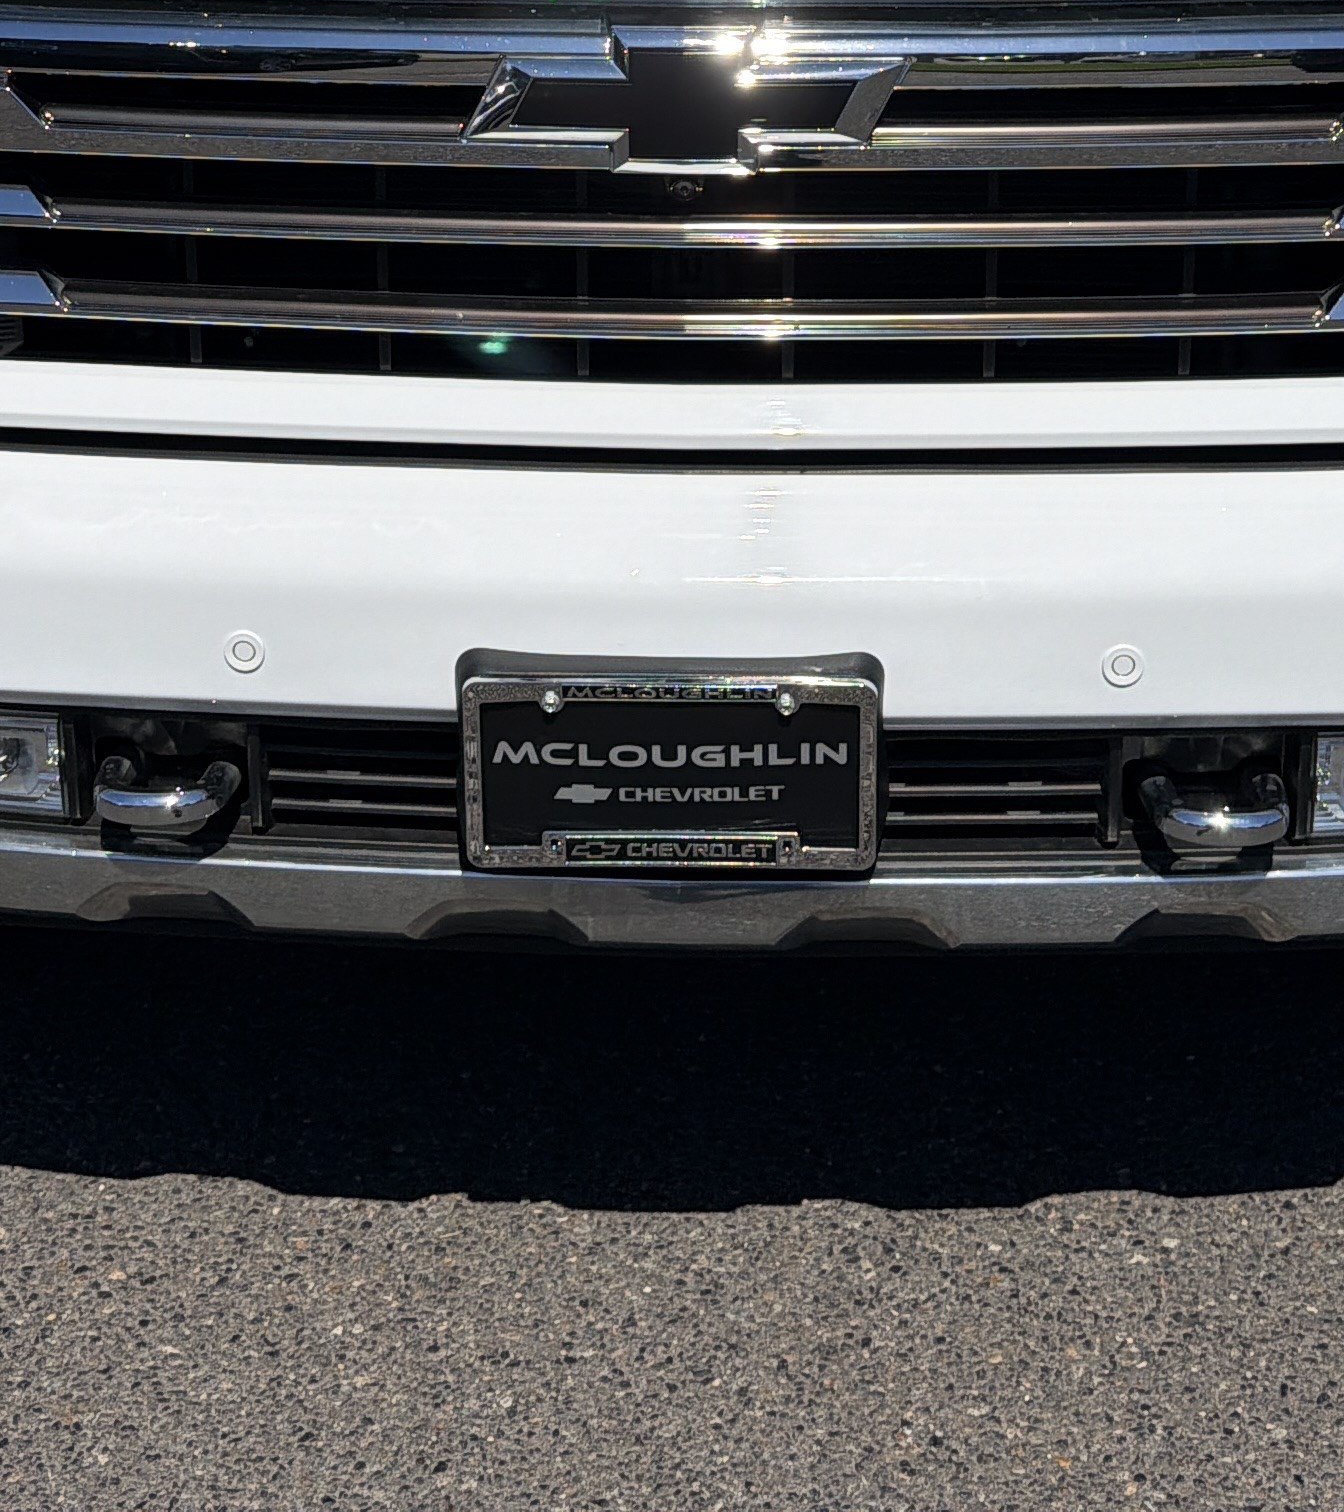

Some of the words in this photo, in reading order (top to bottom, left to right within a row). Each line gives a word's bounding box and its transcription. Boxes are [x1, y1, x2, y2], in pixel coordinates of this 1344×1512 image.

[566, 685, 774, 700] MCLOUGHLIN
[491, 740, 848, 769] MCLOUGHLIN
[618, 785, 785, 803] CHEVROLET
[626, 842, 773, 859] CHEVROLET
